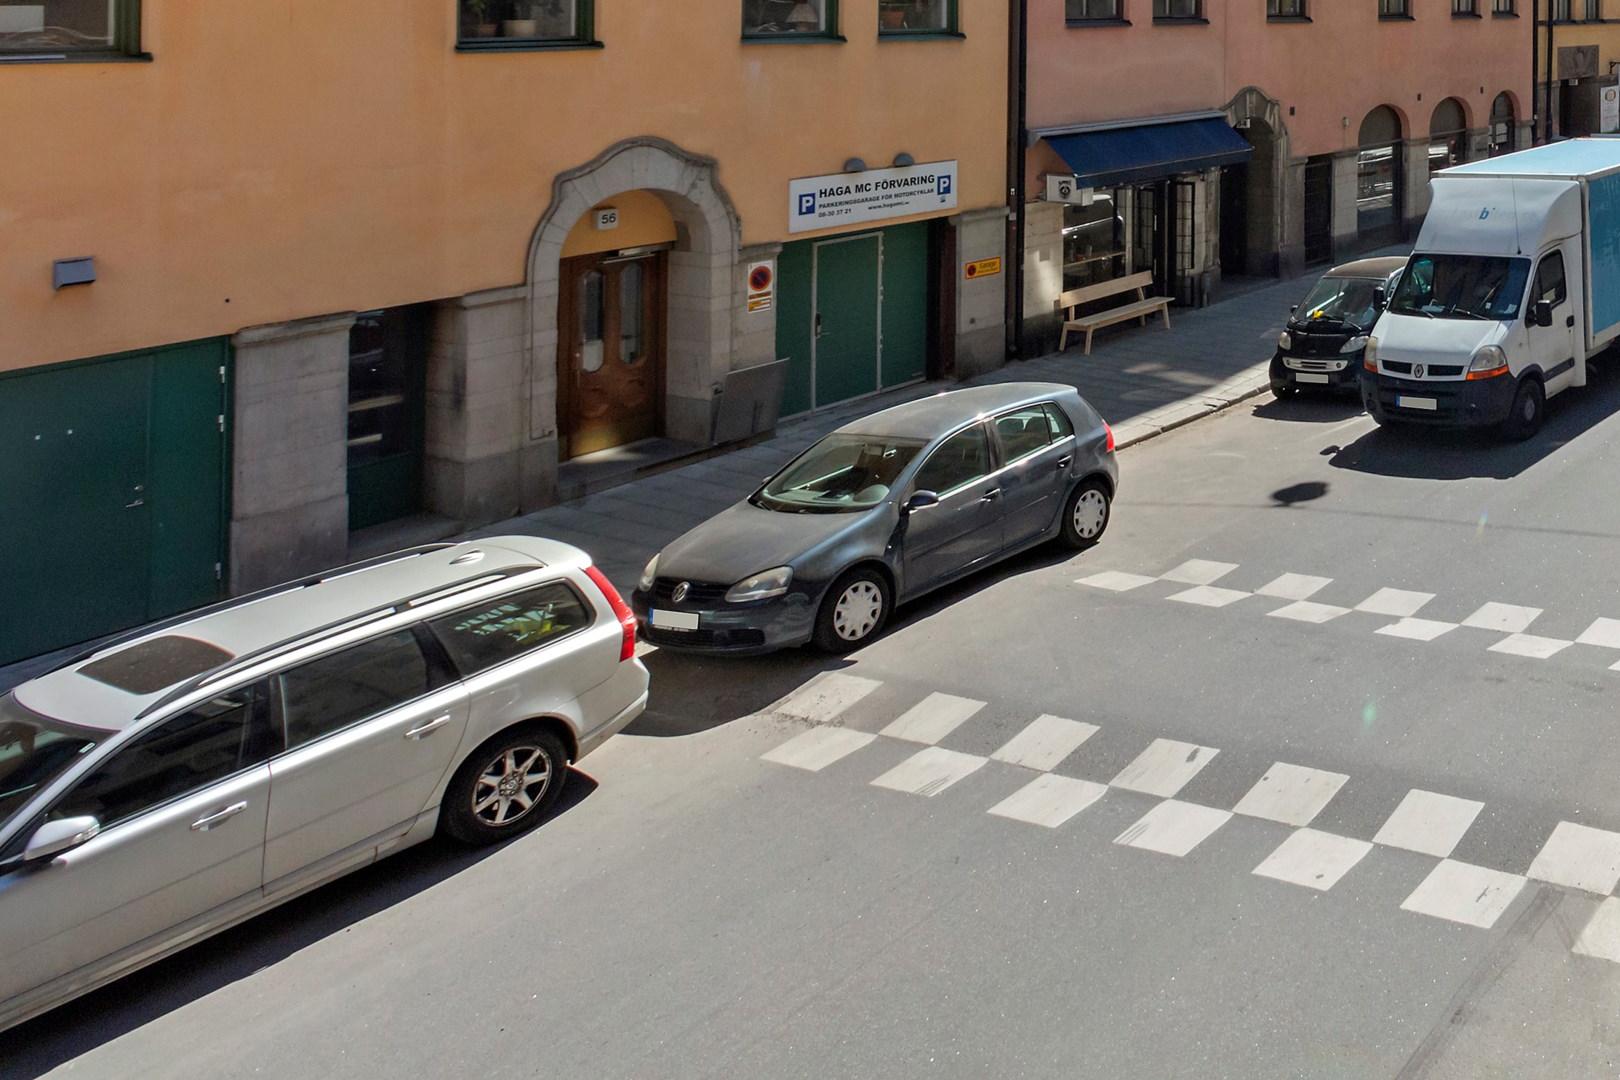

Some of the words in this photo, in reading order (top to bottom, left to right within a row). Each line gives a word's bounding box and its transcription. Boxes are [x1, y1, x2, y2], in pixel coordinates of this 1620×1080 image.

[819, 186, 851, 198] HAGA
[854, 182, 871, 194] MC
[875, 174, 935, 191] FÖRVARING
[940, 177, 950, 193] P
[802, 196, 814, 213] P
[818, 196, 880, 209] PARKERINGSGARAGE
[893, 188, 934, 199] MOTORCYKLAR
[601, 213, 617, 224] 56
